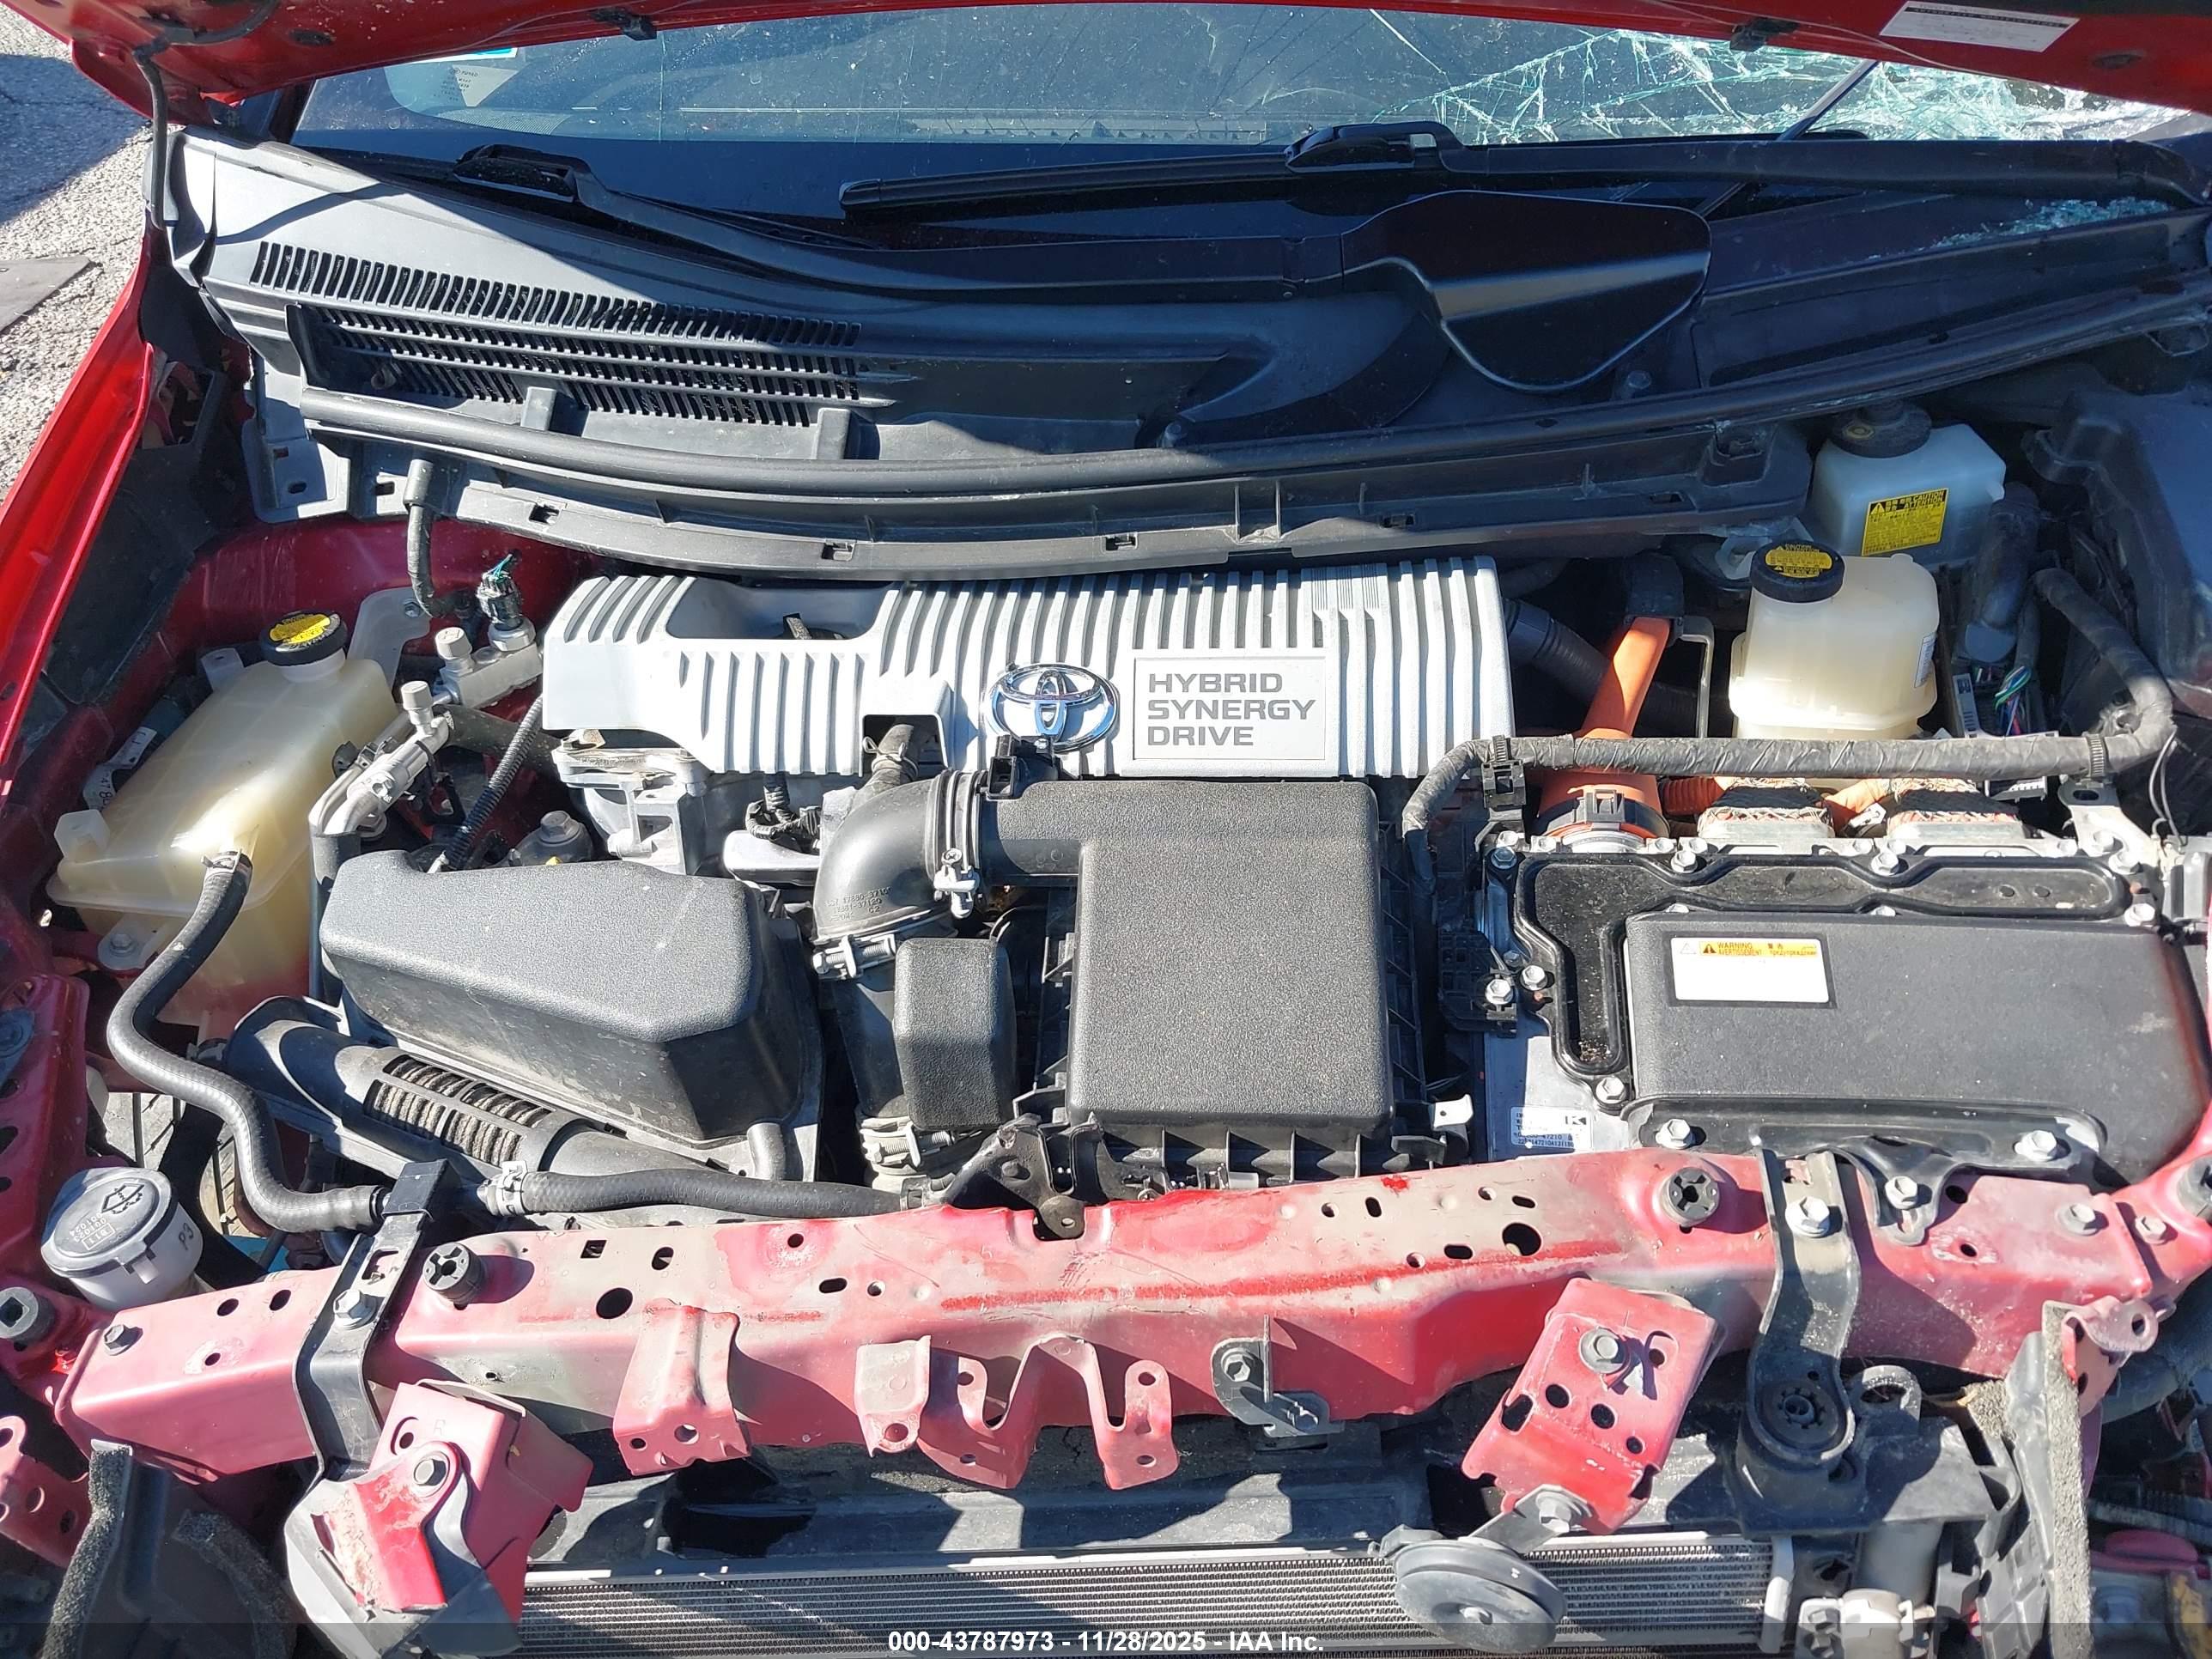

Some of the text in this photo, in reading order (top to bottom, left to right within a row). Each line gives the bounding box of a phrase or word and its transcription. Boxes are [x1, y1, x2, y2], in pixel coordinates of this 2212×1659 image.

[1904, 496, 1944, 508] ATTENTION
[1912, 490, 1944, 501] CAUTION
[1149, 673, 1283, 693] HYBRID
[1148, 699, 1316, 720] SYNERGY
[1147, 726, 1255, 746] DRIVE
